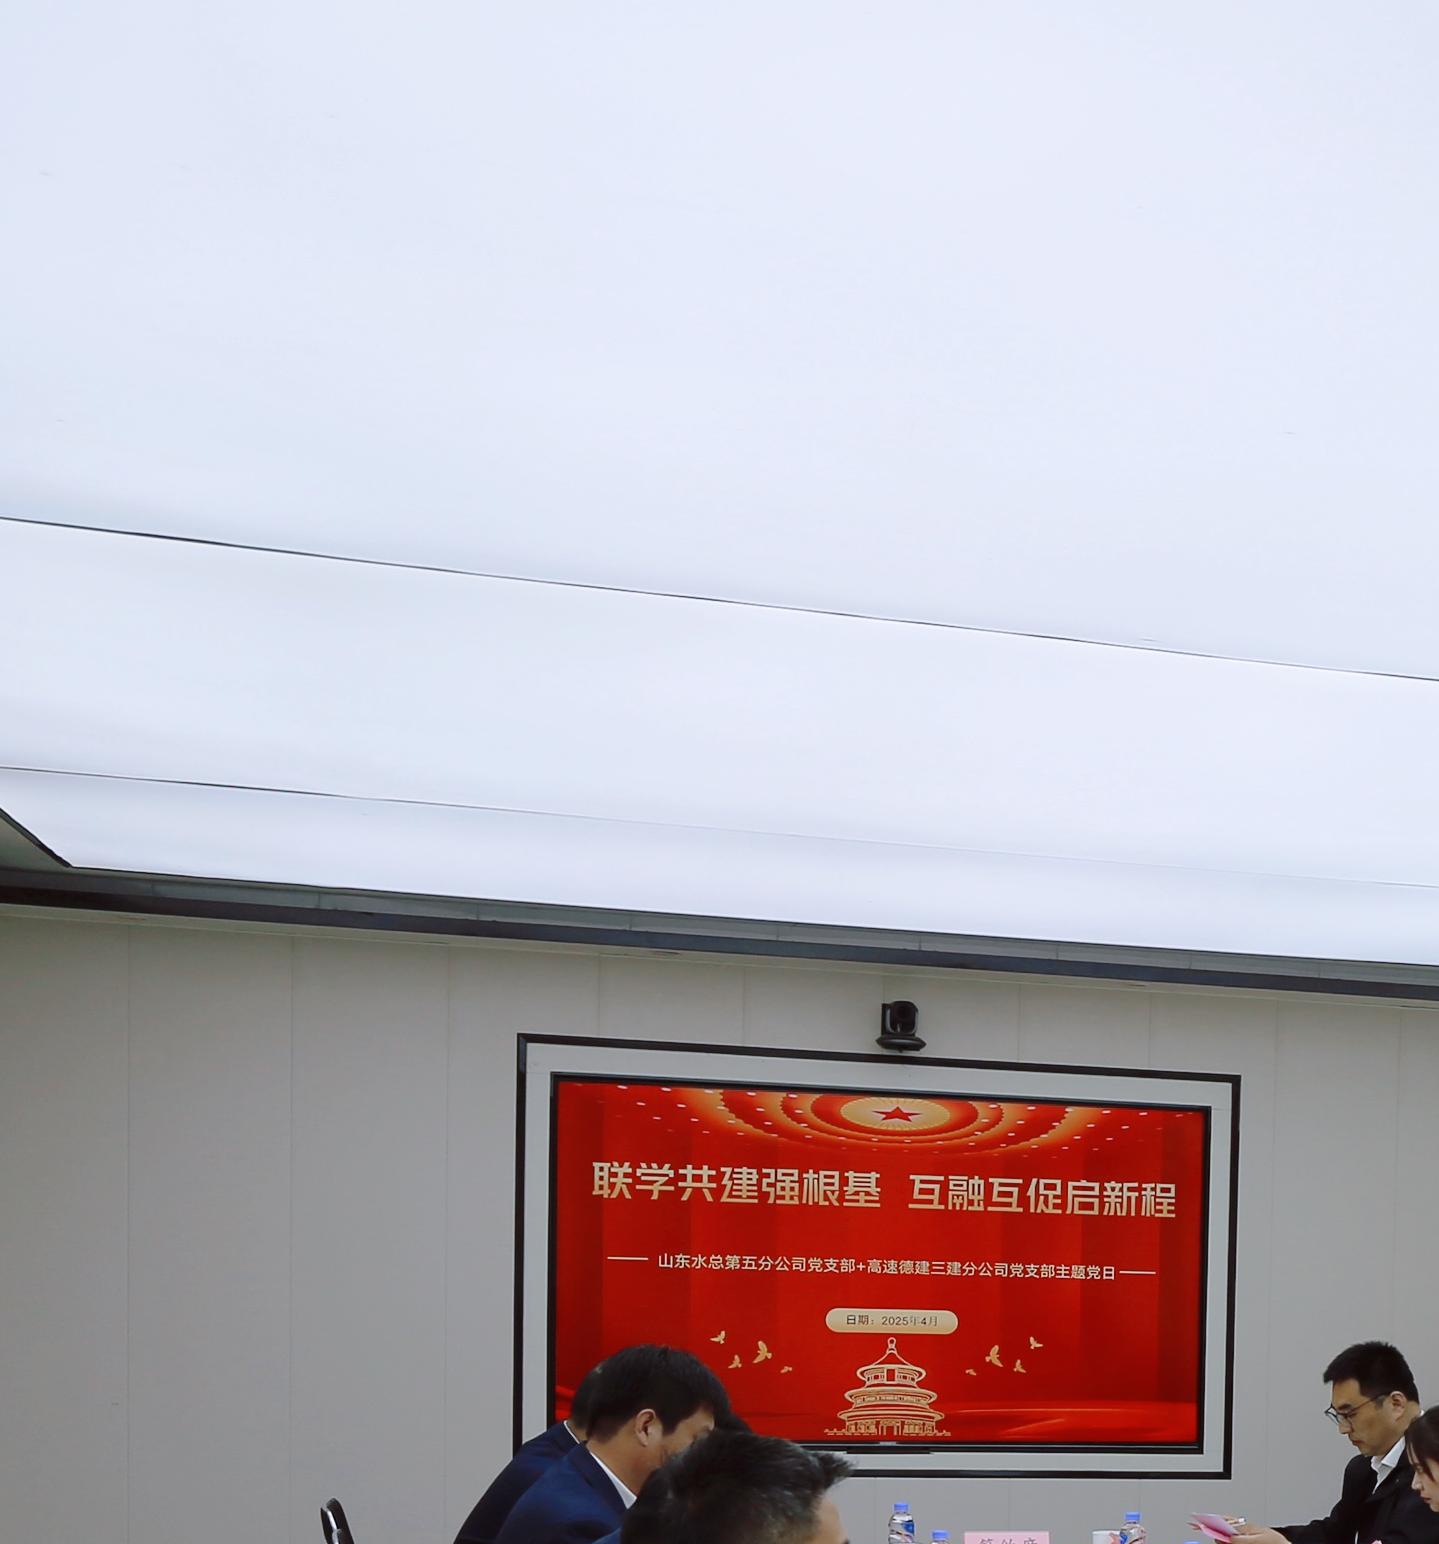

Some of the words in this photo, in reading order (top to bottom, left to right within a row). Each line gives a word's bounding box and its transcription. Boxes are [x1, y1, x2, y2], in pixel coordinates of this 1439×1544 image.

[592, 1161, 881, 1207] 联学共建强根基
[908, 1174, 1176, 1218] 互融互促启新程
[657, 1252, 1116, 1281] 山东水总第五分公司党支部+高速德建三建分公司党支部主题党日
